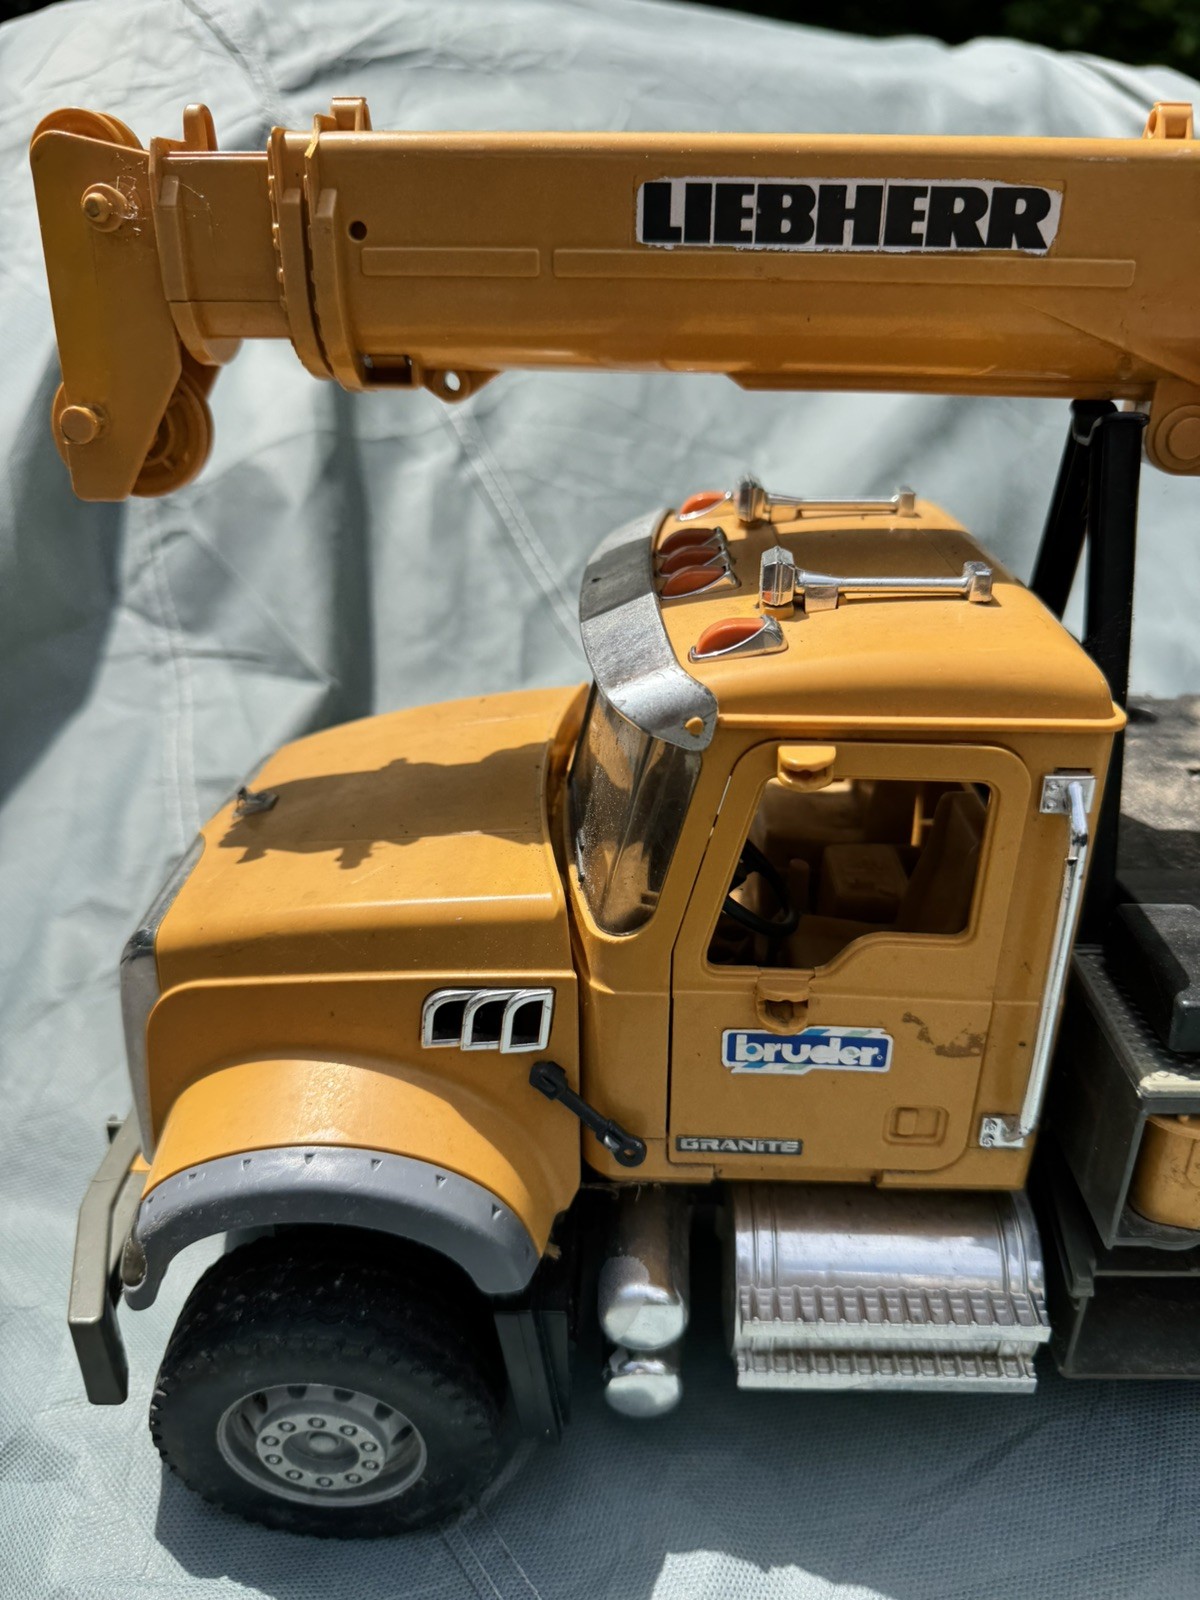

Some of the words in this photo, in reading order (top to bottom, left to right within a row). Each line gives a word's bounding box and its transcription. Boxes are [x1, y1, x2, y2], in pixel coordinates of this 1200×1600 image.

[642, 182, 1051, 249] LIEBHERR
[735, 1034, 879, 1066] bruder
[680, 1137, 799, 1153] GRANITE
